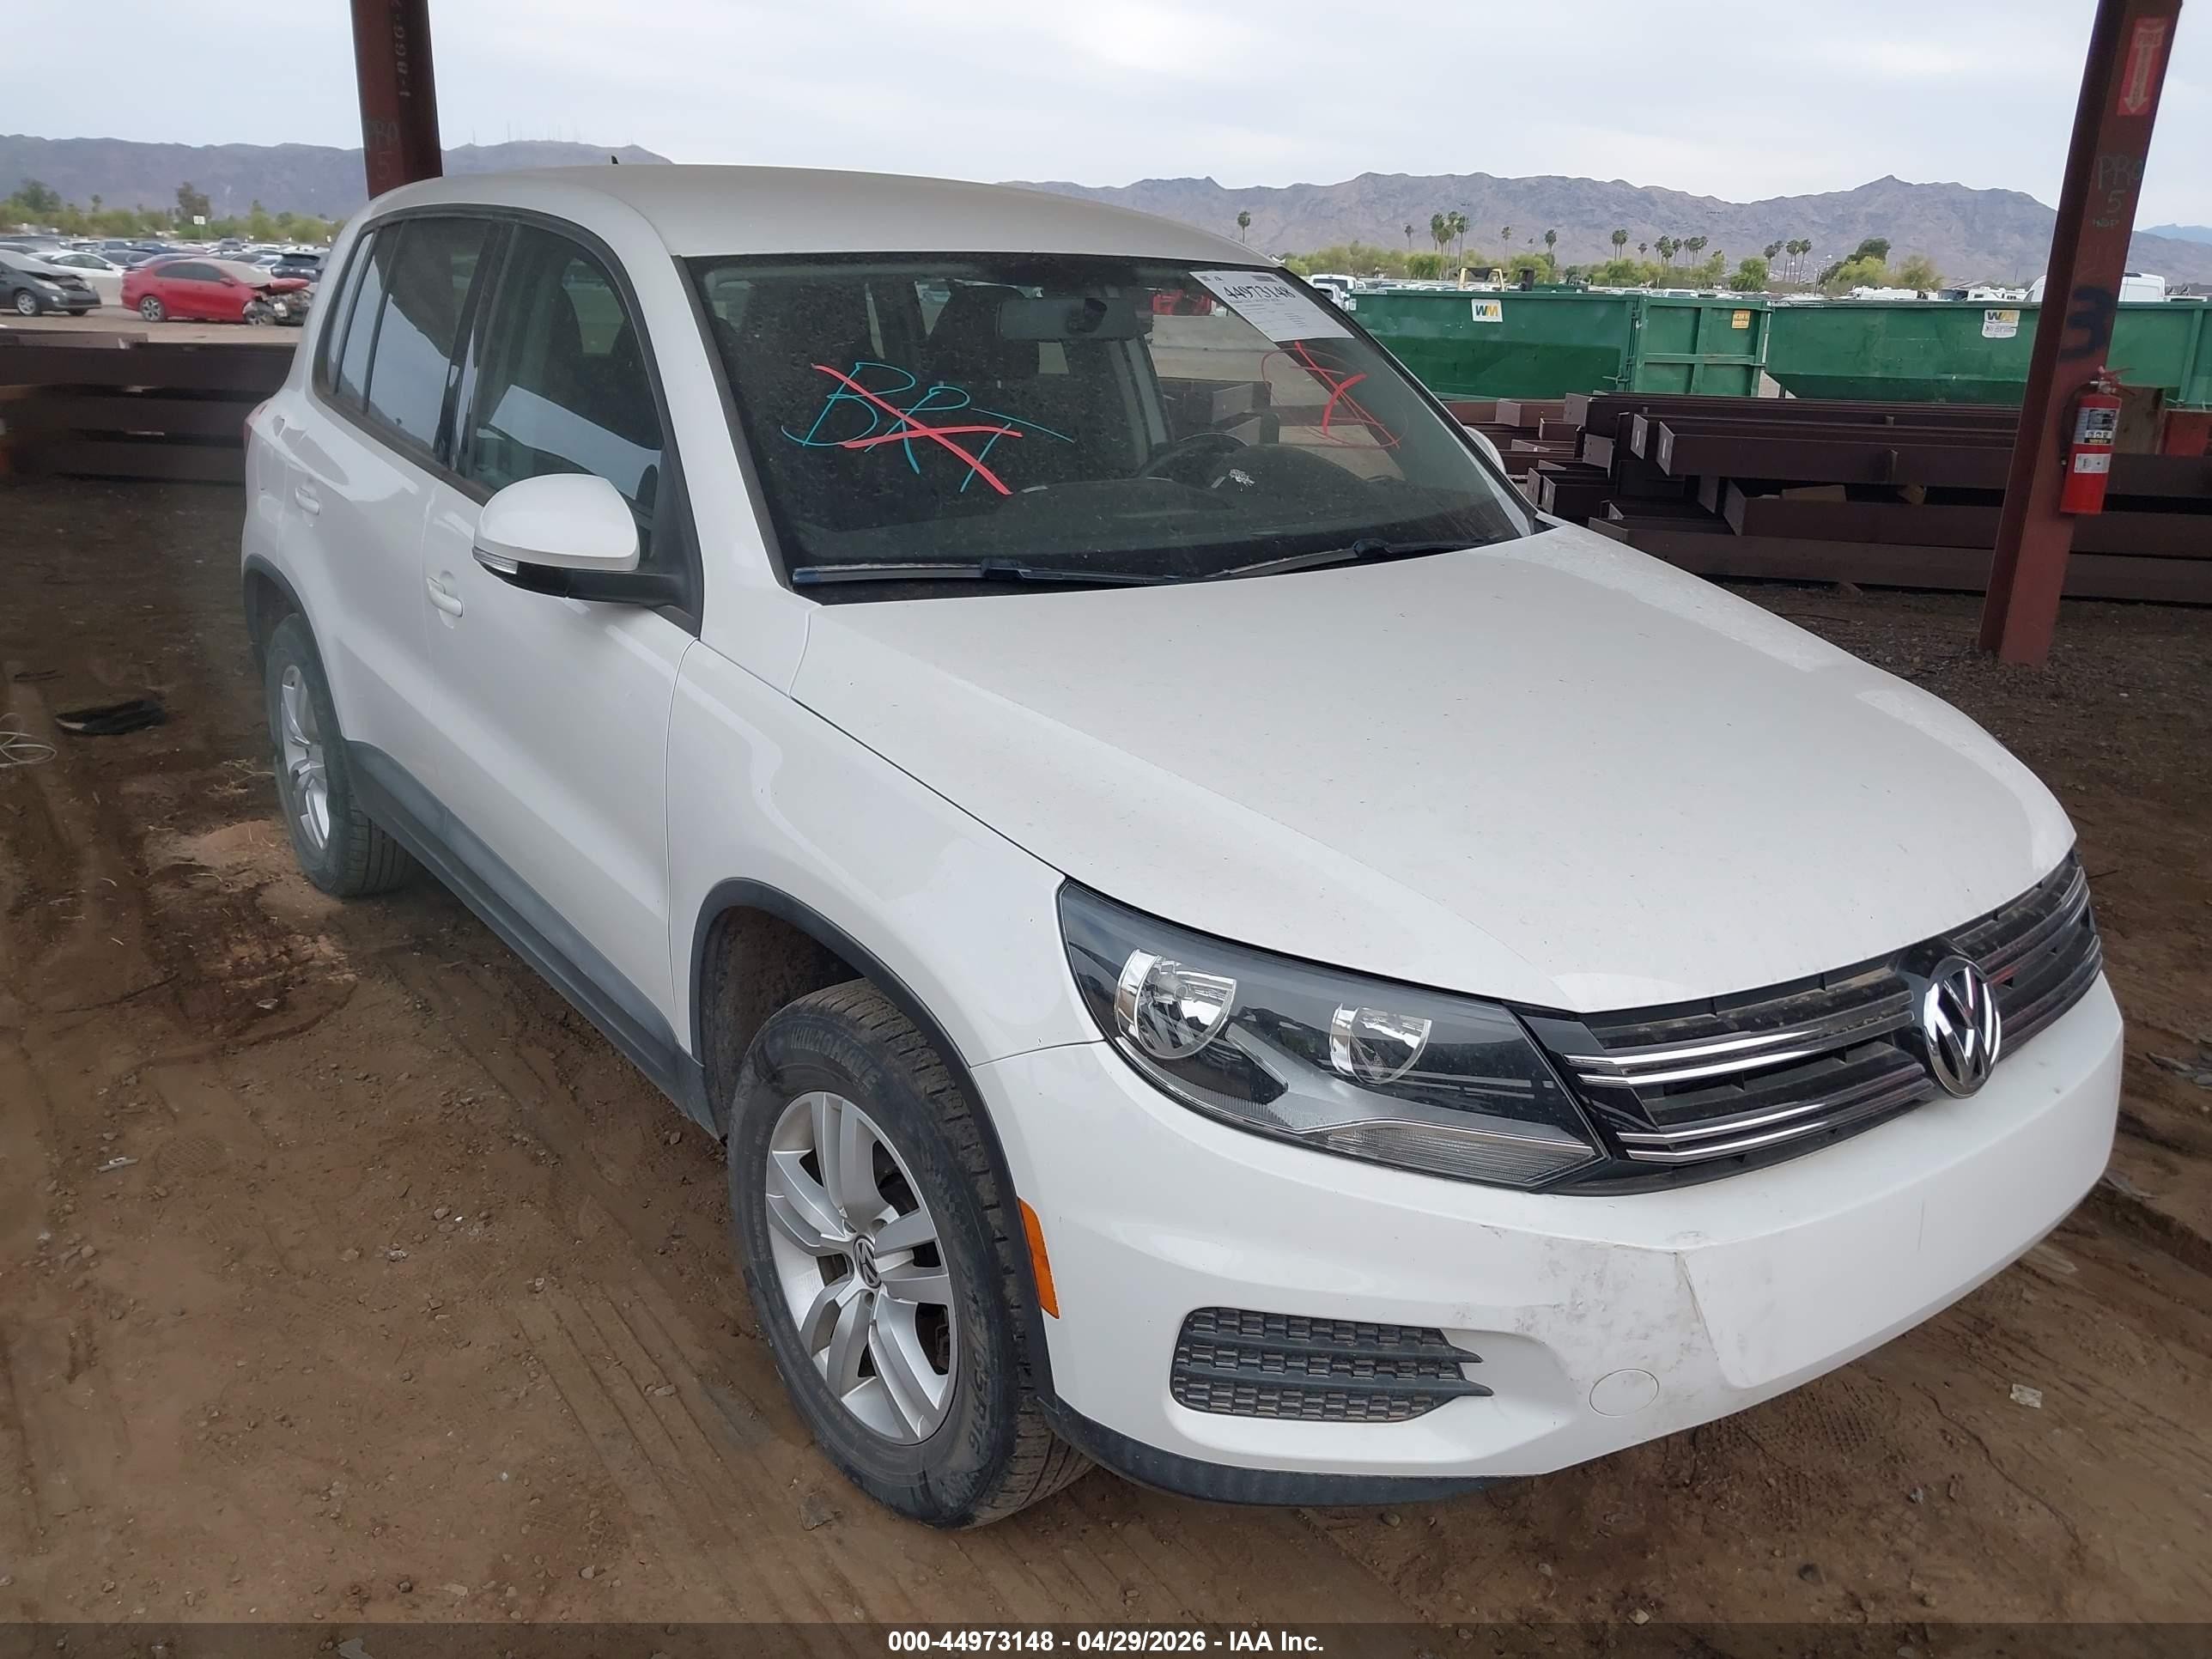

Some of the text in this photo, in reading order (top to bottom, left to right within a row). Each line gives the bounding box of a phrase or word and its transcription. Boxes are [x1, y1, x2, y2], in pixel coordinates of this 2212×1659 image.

[2106, 190, 2127, 214] 5
[1224, 285, 1296, 299] 44973148
[1475, 305, 1498, 317] WM
[2061, 286, 2116, 361] 3
